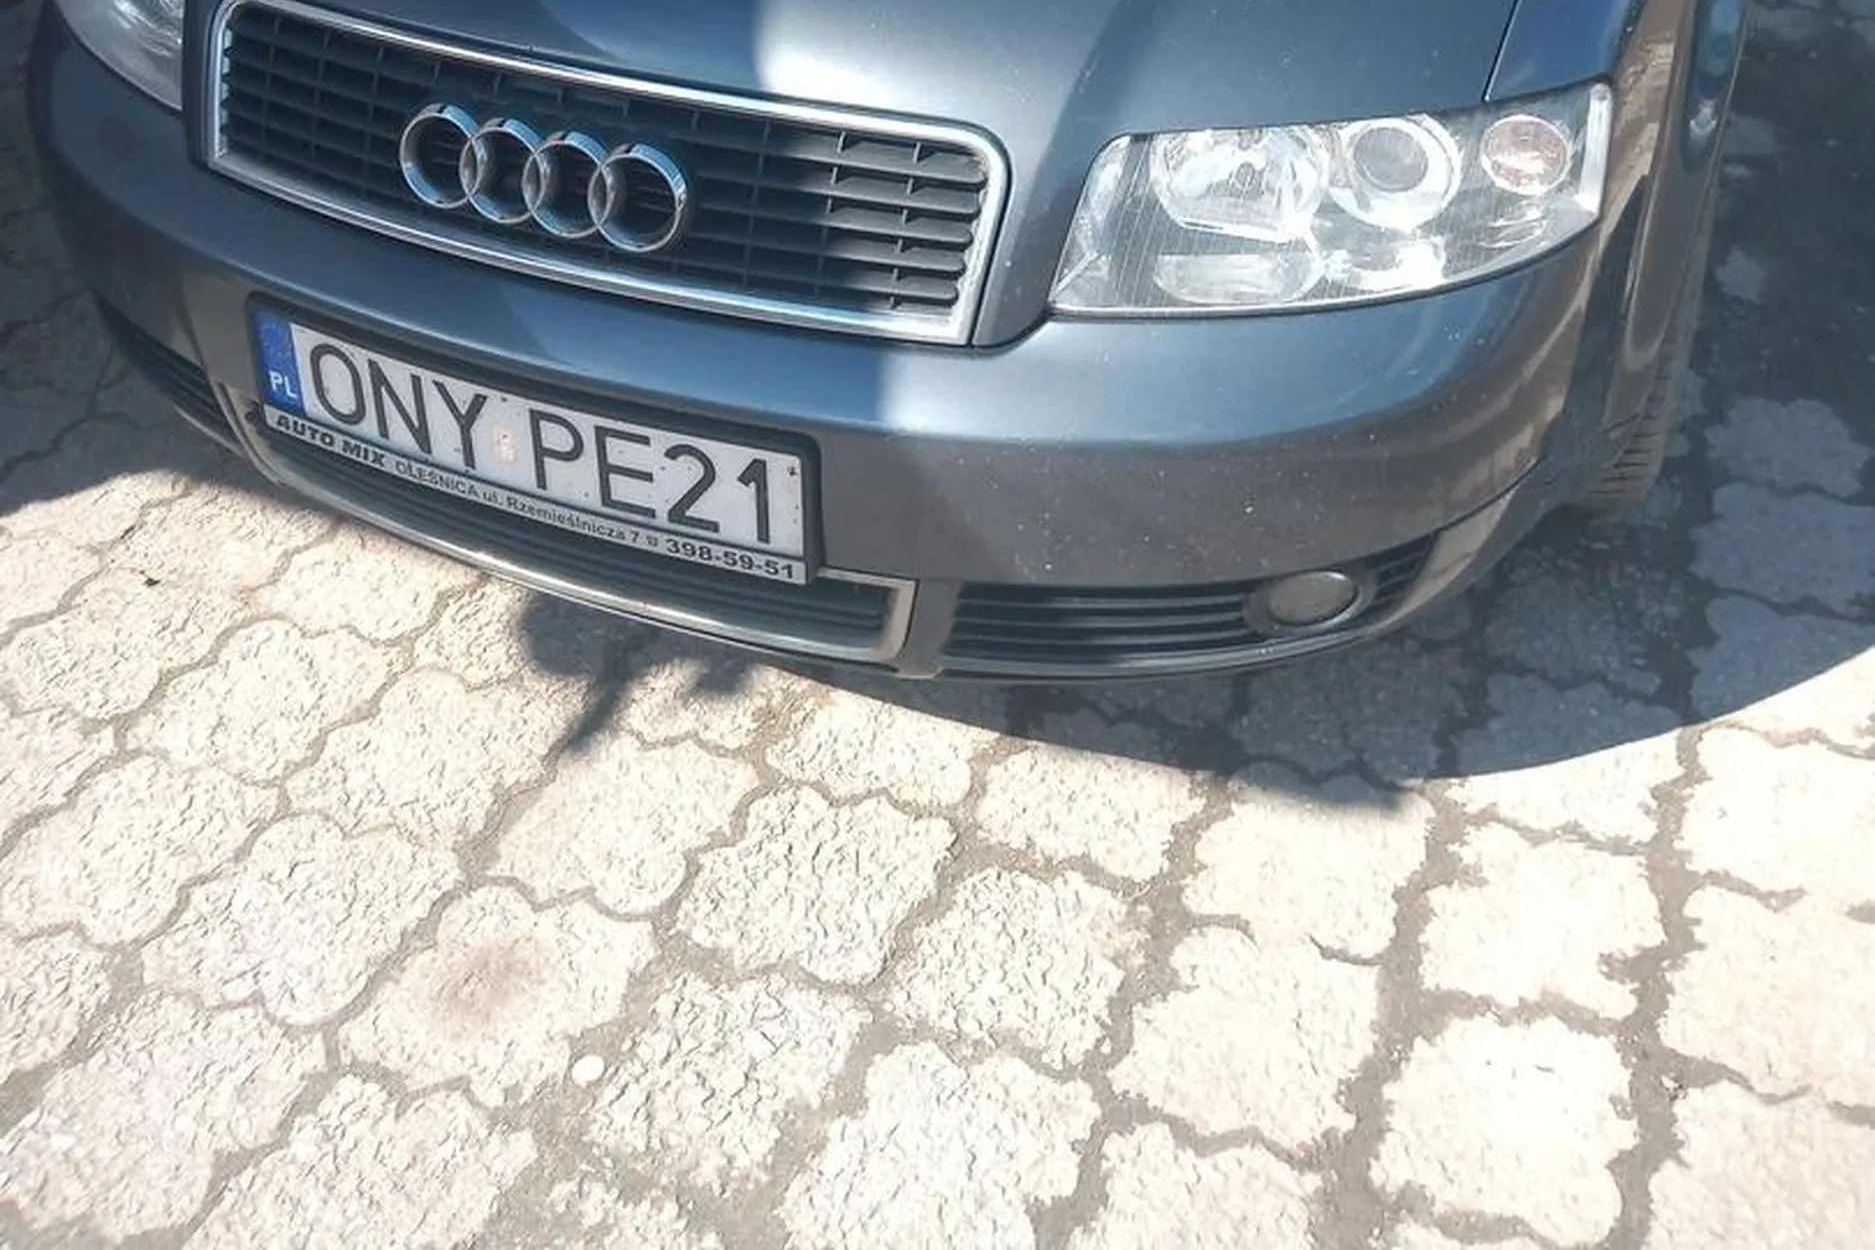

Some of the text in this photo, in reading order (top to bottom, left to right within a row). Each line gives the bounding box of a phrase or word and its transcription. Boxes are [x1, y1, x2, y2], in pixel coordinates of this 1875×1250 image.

[269, 371, 297, 400] PL
[310, 343, 771, 544] ONY PE21
[276, 414, 336, 448] AUTO
[342, 440, 385, 467] MIX
[483, 491, 502, 506] ul.
[507, 496, 625, 541] Rzemieślnicza
[629, 529, 640, 543] 7
[665, 538, 794, 579] 398-59-51
